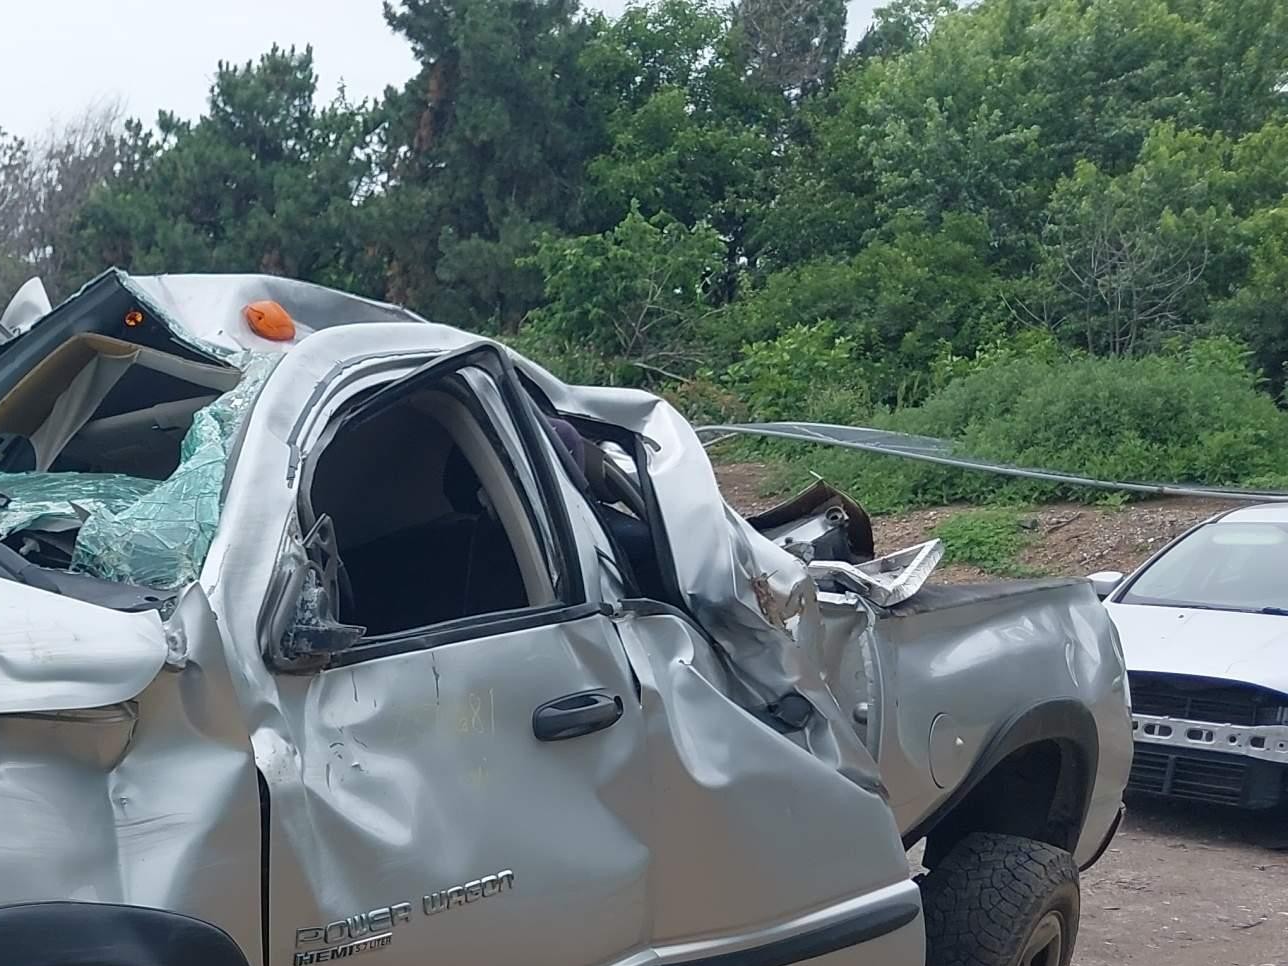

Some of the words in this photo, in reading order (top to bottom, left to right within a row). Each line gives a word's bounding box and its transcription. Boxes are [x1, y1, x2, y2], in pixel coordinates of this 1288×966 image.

[296, 902, 412, 948] POWER
[423, 869, 514, 916] WAGON
[293, 944, 354, 966] HEMI
[369, 936, 392, 949] LITER
